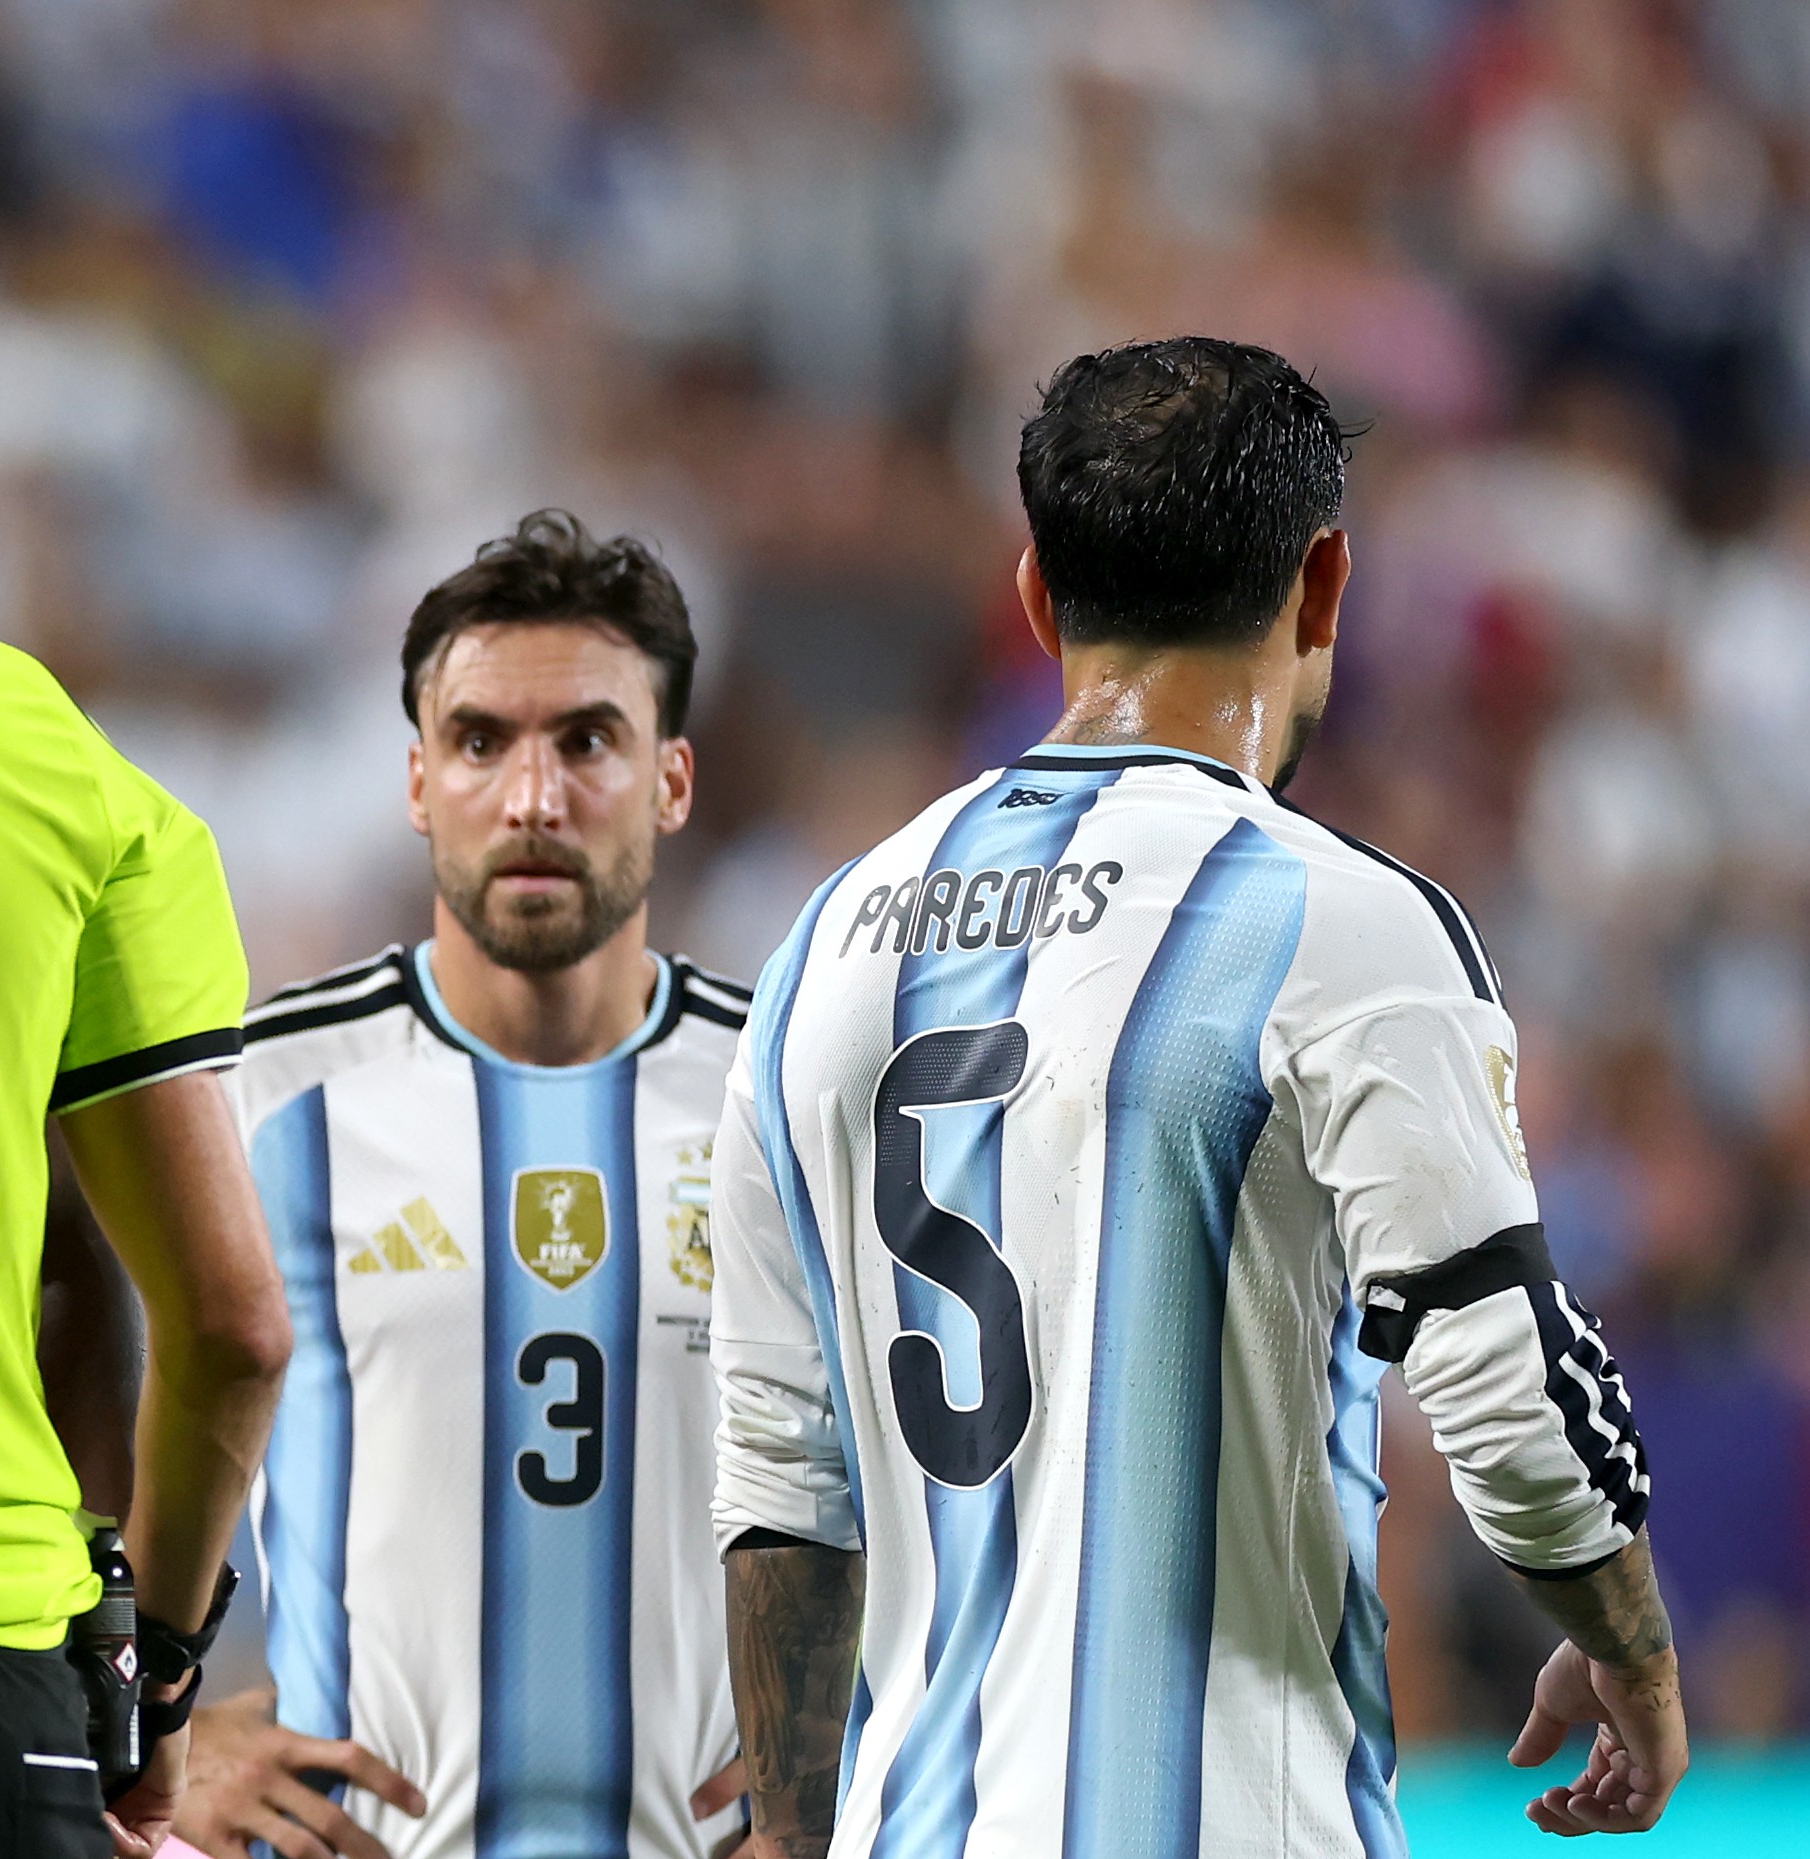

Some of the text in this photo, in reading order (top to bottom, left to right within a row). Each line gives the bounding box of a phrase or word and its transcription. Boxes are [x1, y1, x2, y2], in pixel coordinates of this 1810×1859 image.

[838, 859, 1126, 960] PAREDES
[873, 1020, 1036, 1491] 5
[514, 1330, 606, 1508] 3
